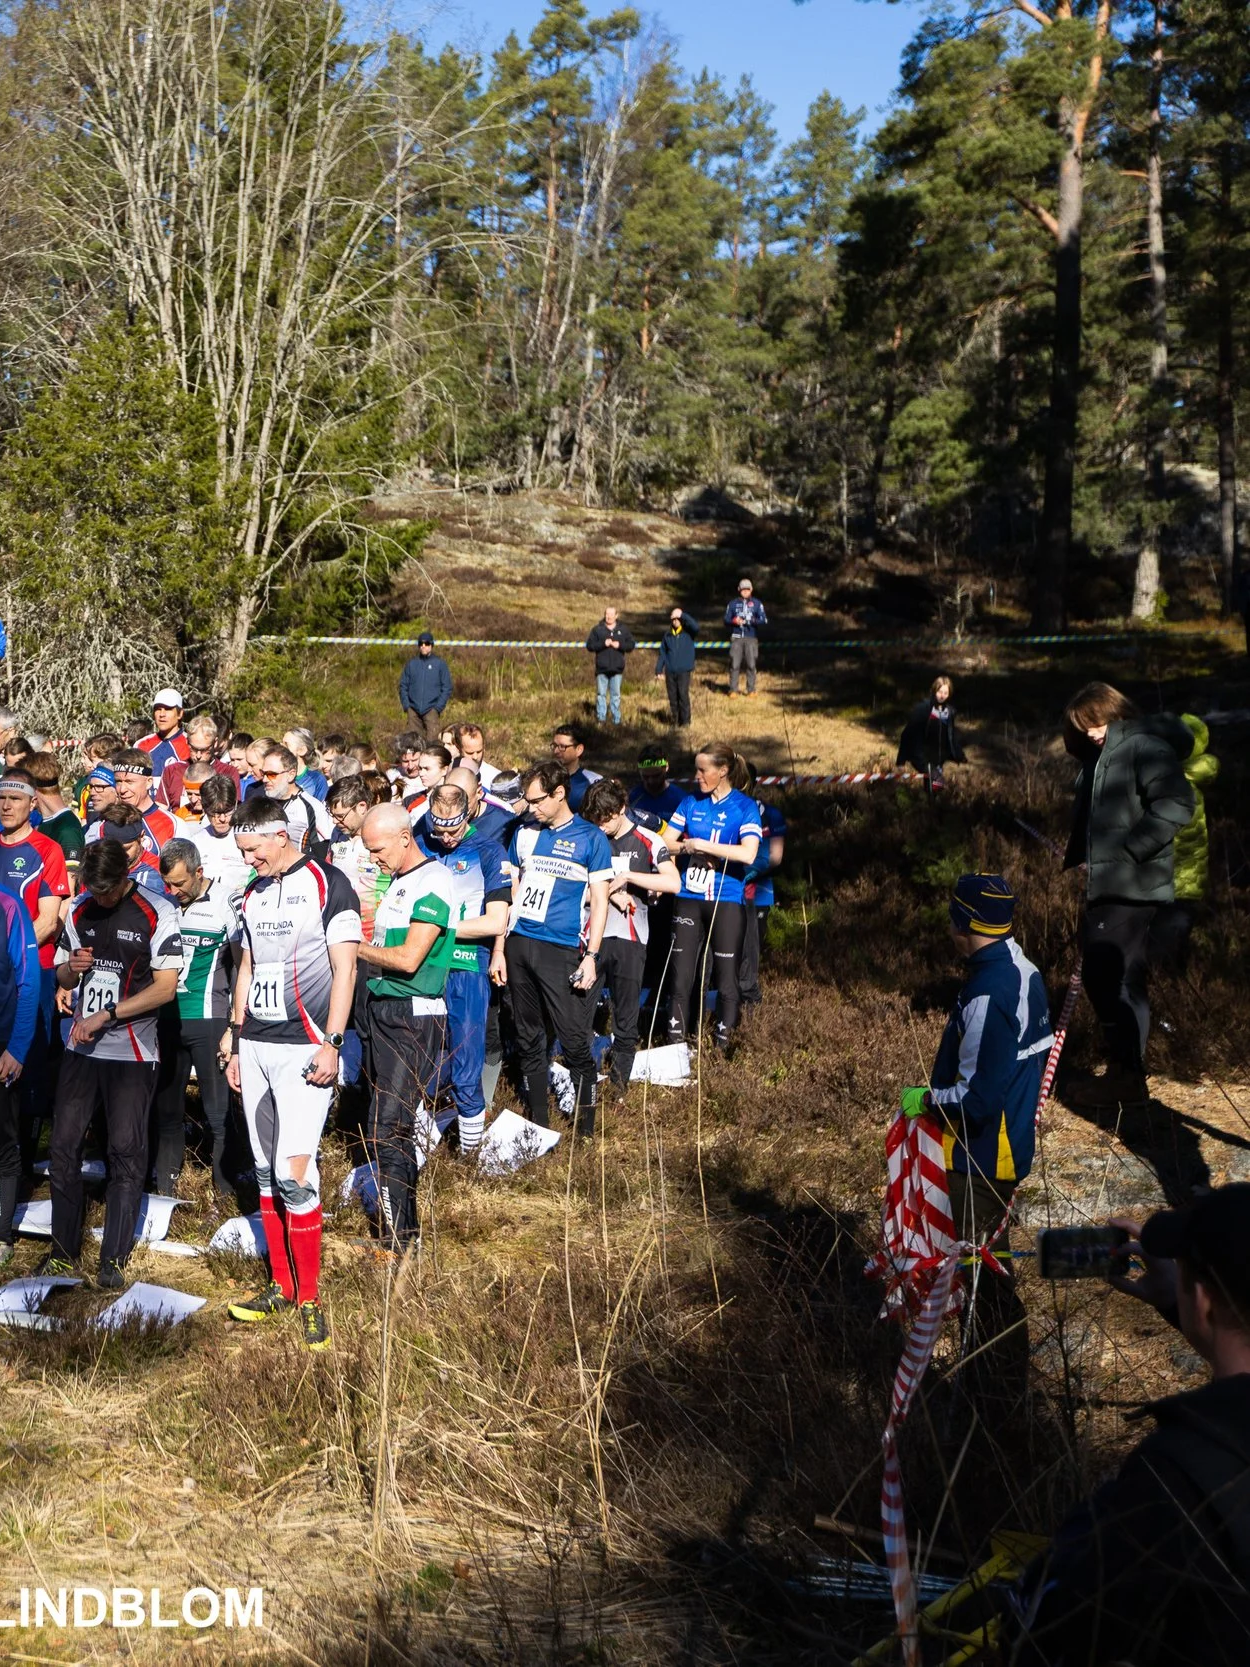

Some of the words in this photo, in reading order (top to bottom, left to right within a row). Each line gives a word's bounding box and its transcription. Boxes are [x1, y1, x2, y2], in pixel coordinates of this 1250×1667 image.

[535, 866, 567, 876] NYKVARN
[522, 887, 546, 910] 241
[255, 921, 294, 930] ATTUNDA
[453, 949, 477, 960] ÖRN
[93, 959, 124, 969] TUNDA
[254, 981, 278, 1008] 211
